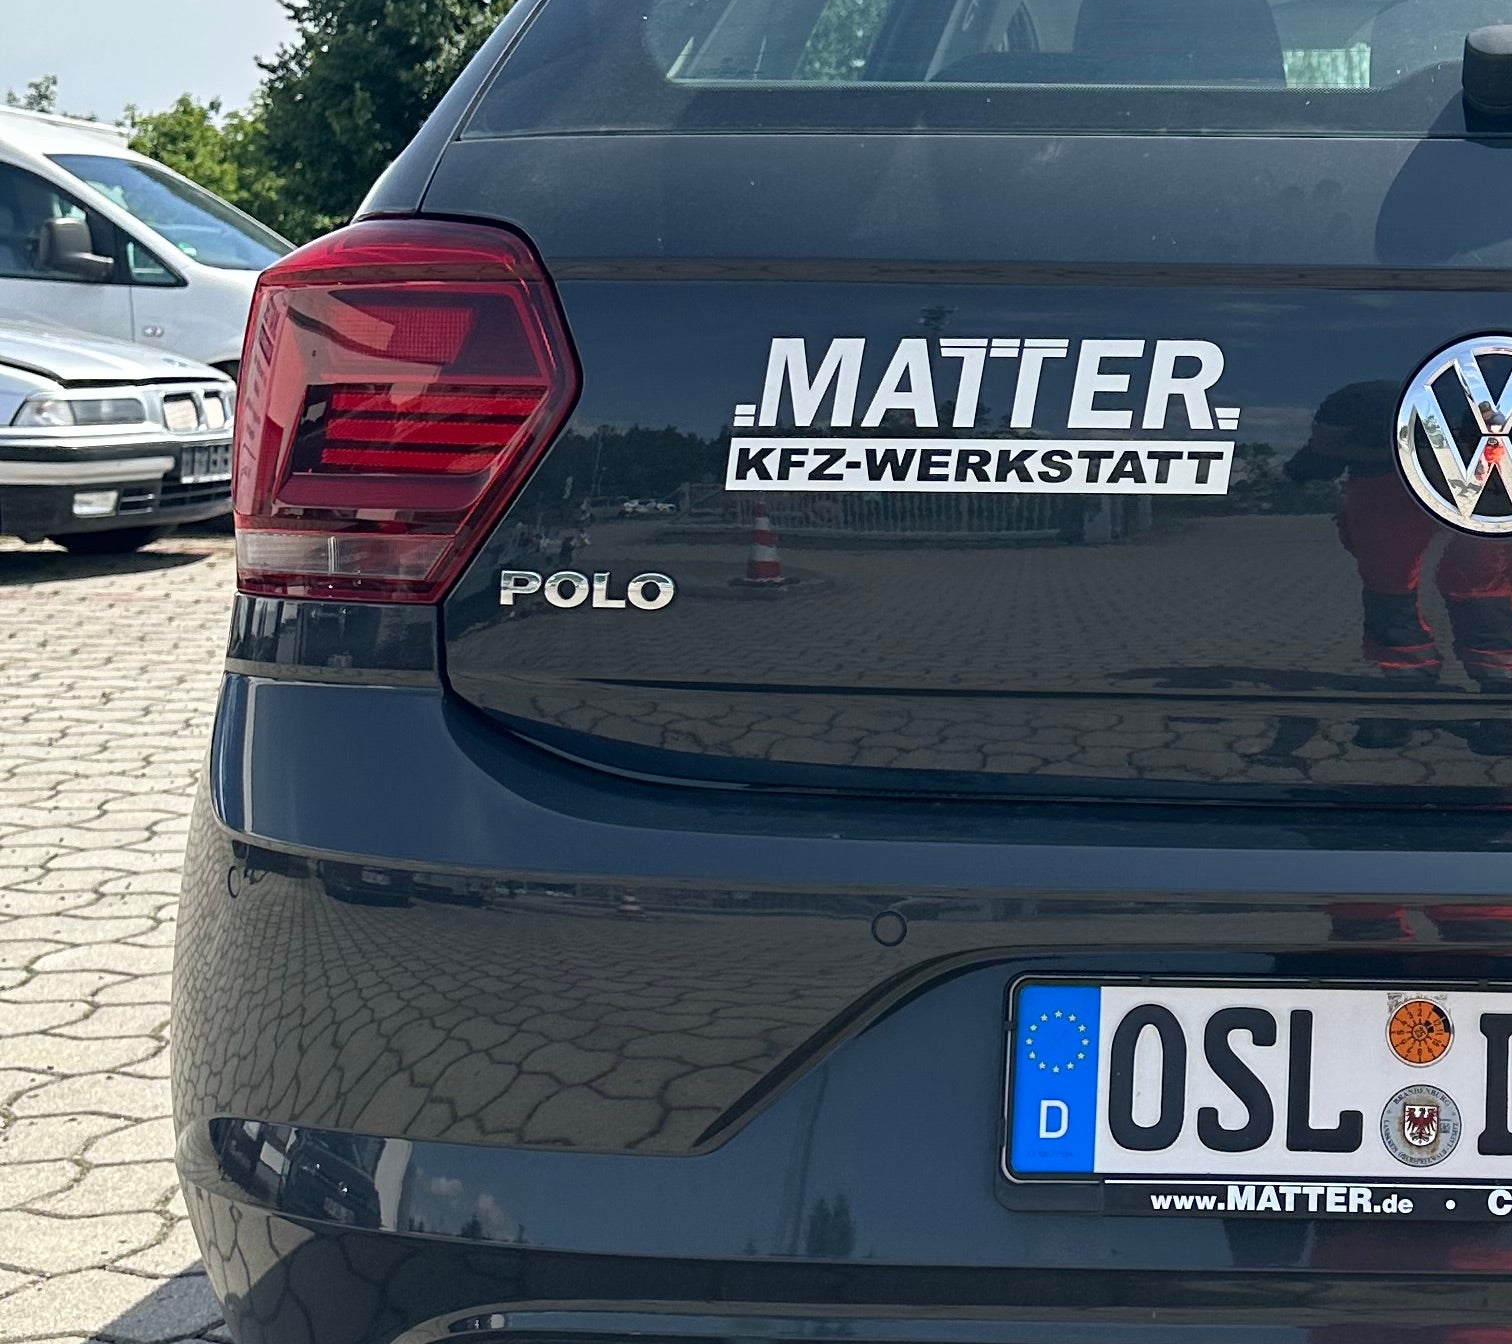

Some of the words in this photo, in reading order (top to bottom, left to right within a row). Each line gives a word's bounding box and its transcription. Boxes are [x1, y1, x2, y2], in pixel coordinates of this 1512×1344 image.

[735, 446, 1224, 485] KFZ-WERKSTATT
[500, 570, 675, 610] POLO
[1108, 1003, 1363, 1153] OSL
[1038, 1099, 1069, 1139] D
[1150, 1186, 1414, 1214] www.MATTER.de
